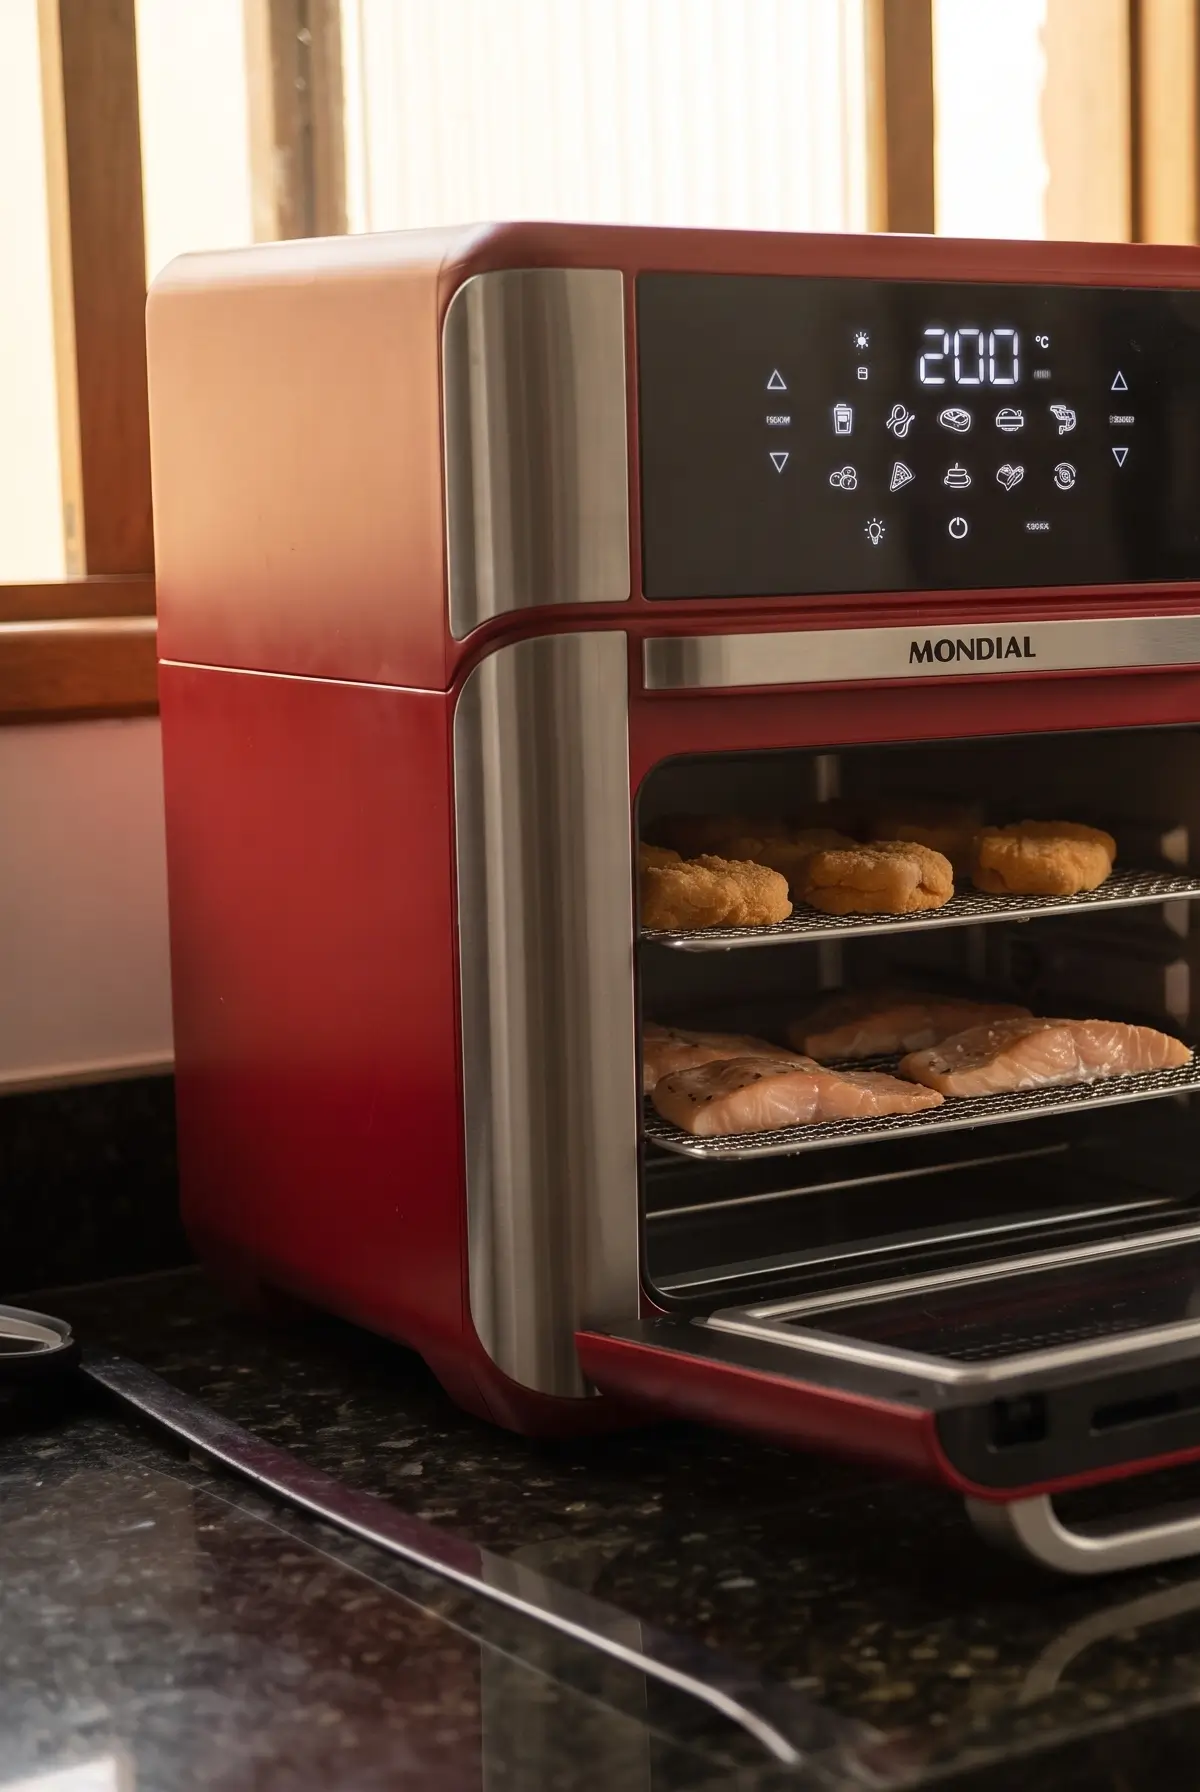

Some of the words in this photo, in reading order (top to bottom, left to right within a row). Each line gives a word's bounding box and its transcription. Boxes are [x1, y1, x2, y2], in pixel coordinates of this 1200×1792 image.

[919, 328, 1019, 385] 200
[1035, 335, 1049, 349] °C
[909, 636, 1036, 664] MONDIAL
